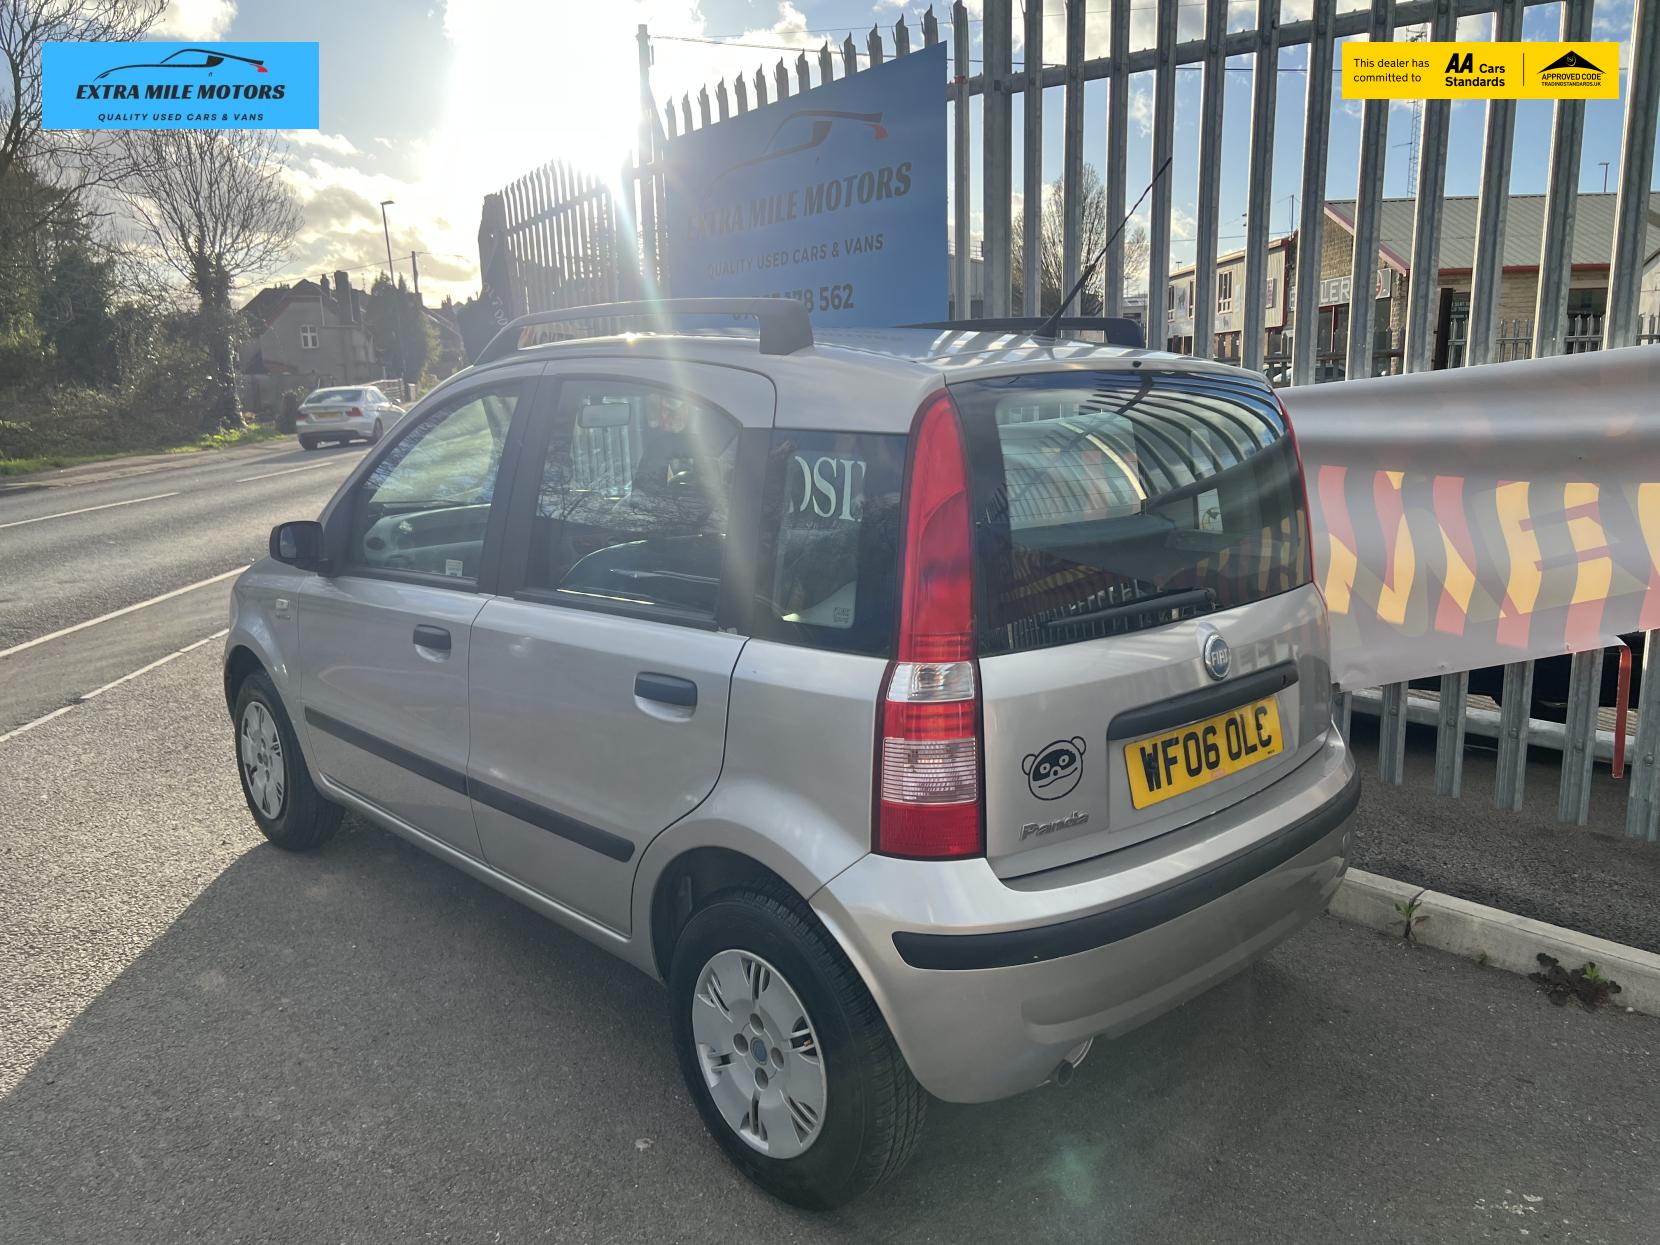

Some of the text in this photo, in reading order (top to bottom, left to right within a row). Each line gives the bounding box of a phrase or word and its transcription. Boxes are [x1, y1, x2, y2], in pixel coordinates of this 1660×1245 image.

[748, 190, 798, 229] MILE
[803, 161, 913, 217] MOTORS
[706, 233, 884, 279] QUALITY USED CARS & VANS
[819, 283, 855, 312] 562
[1210, 648, 1229, 666] FIAT
[1018, 810, 1089, 841] Panda
